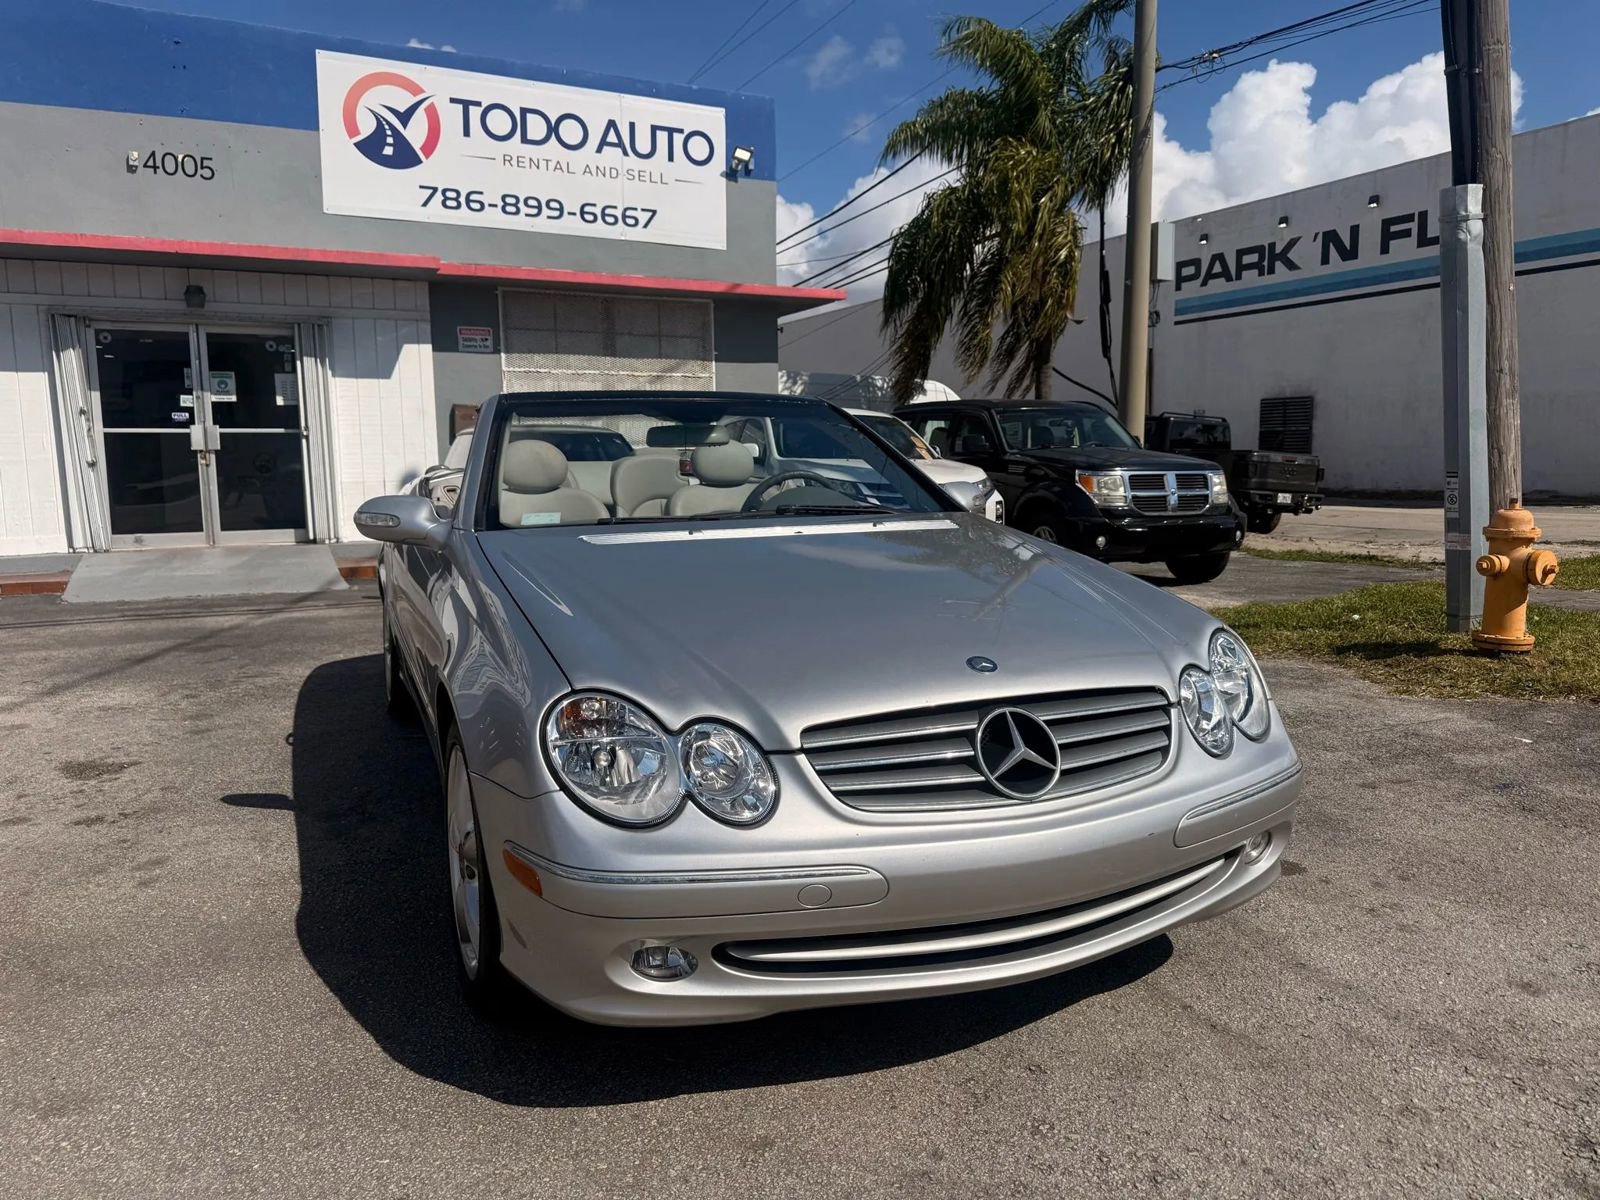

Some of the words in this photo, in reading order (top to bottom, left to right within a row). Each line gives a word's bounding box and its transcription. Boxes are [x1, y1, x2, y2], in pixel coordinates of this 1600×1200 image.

[449, 96, 589, 151] TODO
[595, 119, 715, 167] AUTO
[142, 149, 215, 181] 4005
[502, 153, 576, 175] RENTAL
[582, 162, 620, 180] AND
[625, 168, 669, 185] SELL
[418, 184, 658, 229] 786-899-6667
[1175, 235, 1303, 291] PARK
[1312, 223, 1360, 266] 'N
[1380, 209, 1440, 255] FL
